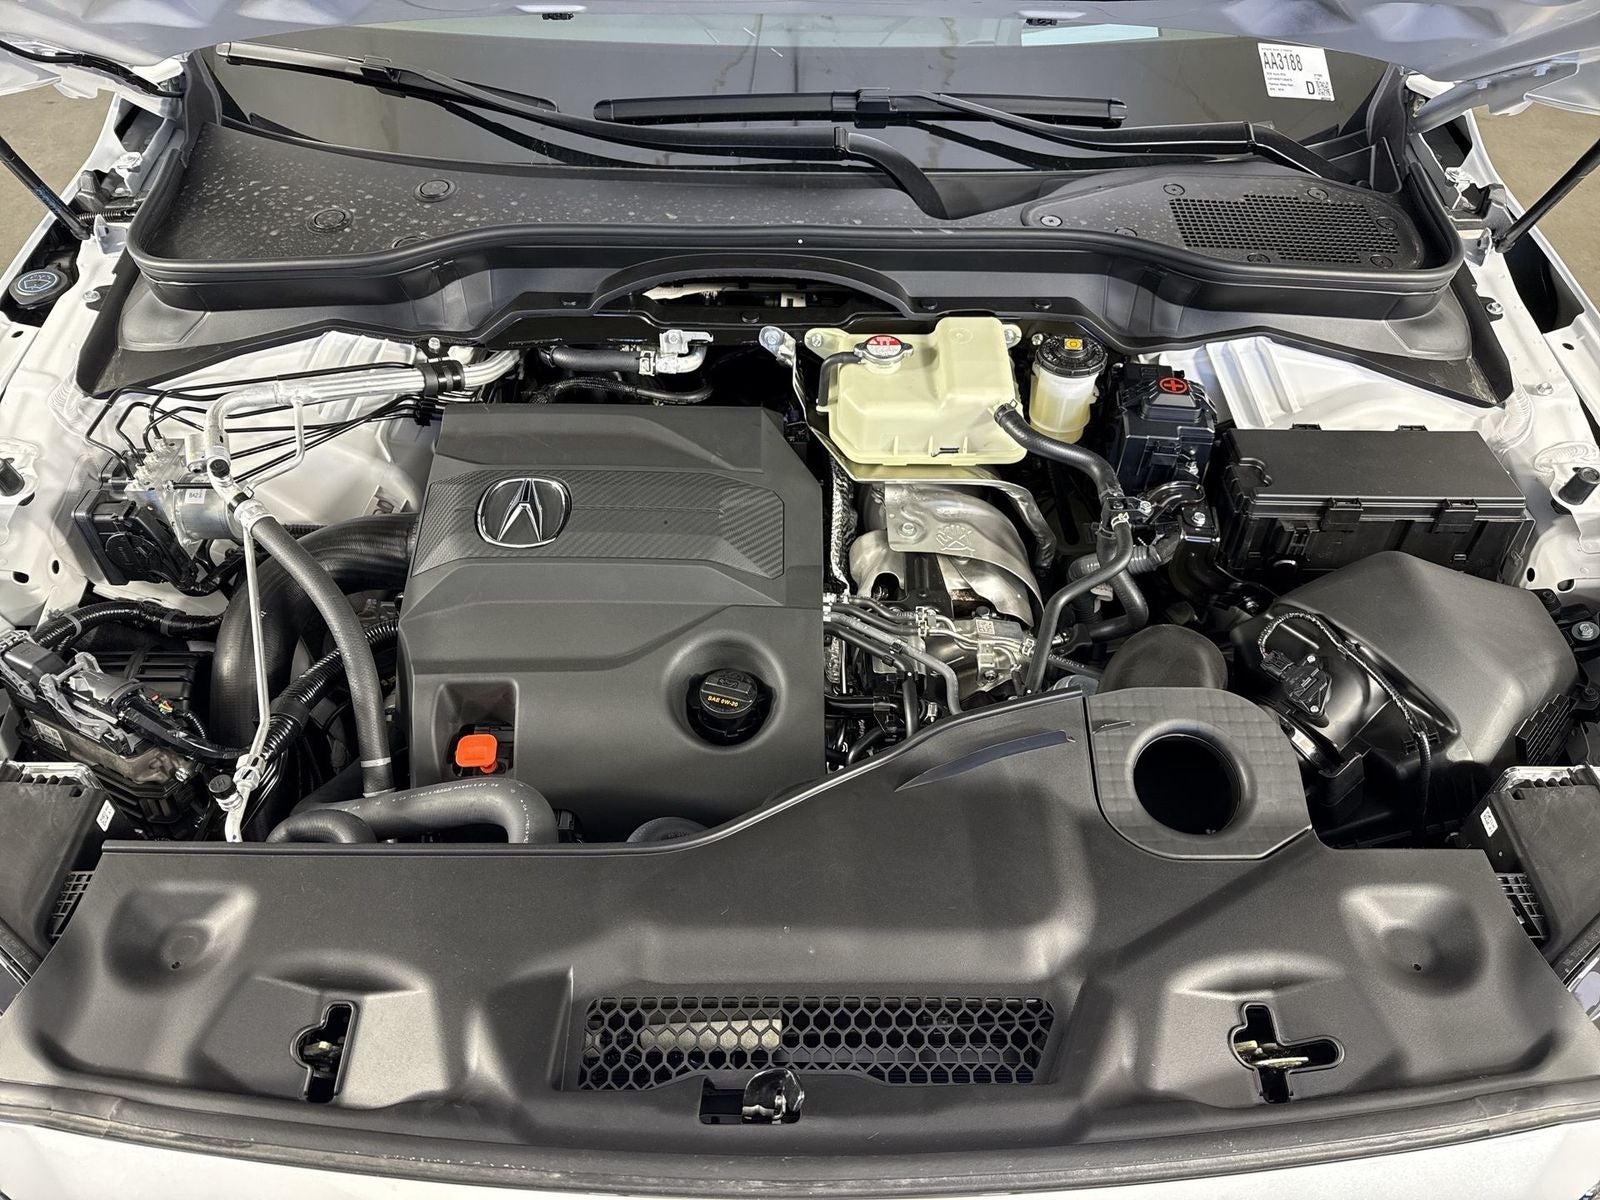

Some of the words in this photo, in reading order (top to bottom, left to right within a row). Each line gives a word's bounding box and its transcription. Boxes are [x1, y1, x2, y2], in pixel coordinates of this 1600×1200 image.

[1263, 52, 1303, 71] AA3188
[1306, 81, 1315, 95] D
[707, 695, 720, 703] SAE
[720, 698, 739, 707] 0W-20
